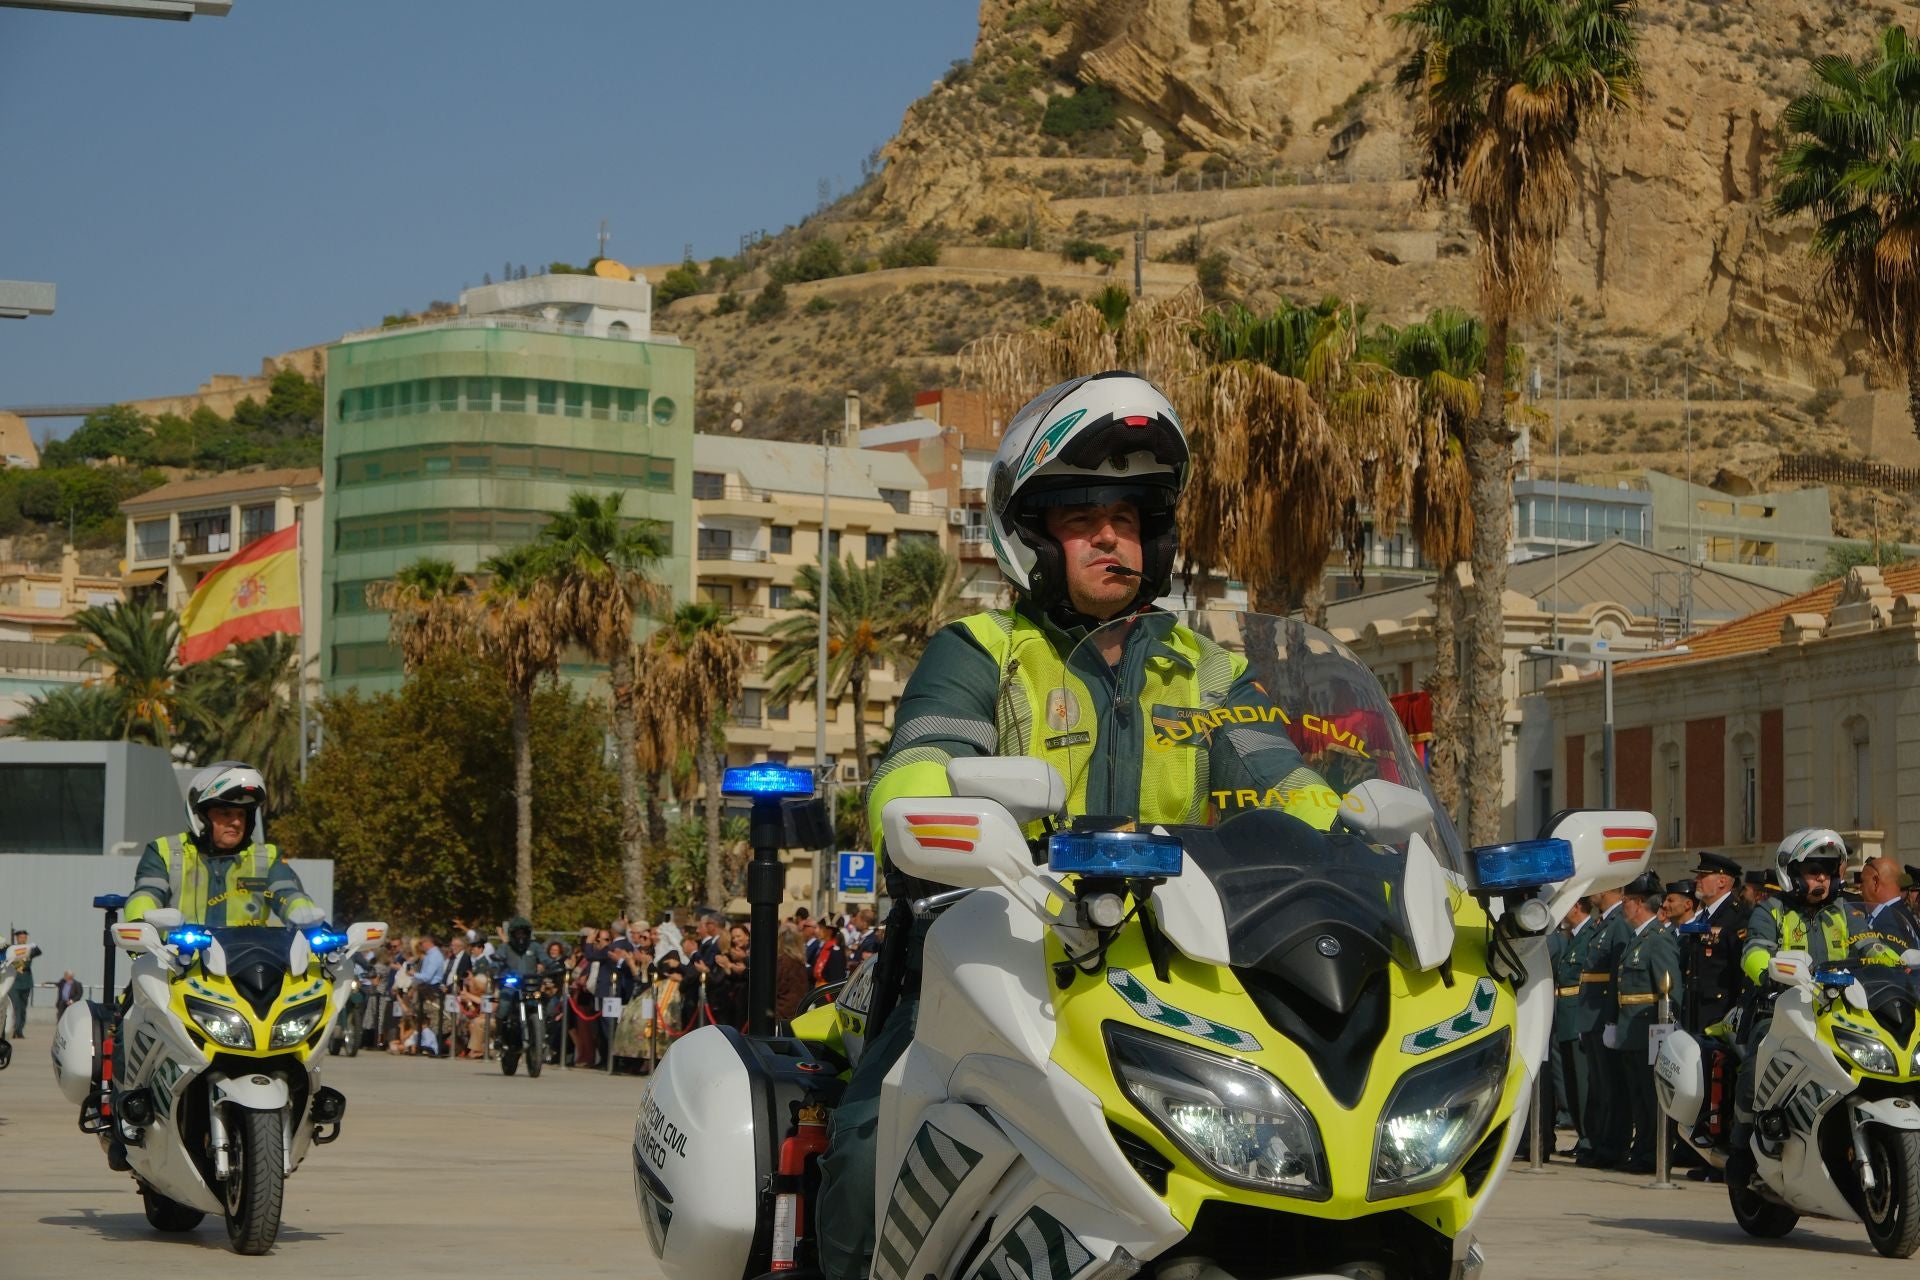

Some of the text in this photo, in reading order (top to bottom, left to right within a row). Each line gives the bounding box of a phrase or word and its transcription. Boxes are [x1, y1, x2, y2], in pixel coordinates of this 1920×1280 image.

[1148, 705, 1371, 759] GUARDIA CIVIL
[1211, 788, 1365, 813] TRAFICO
[849, 855, 865, 878] P
[1886, 933, 1909, 949] CIVIL
[1860, 957, 1907, 967] TRACO
[663, 1122, 688, 1159] CIVIL
